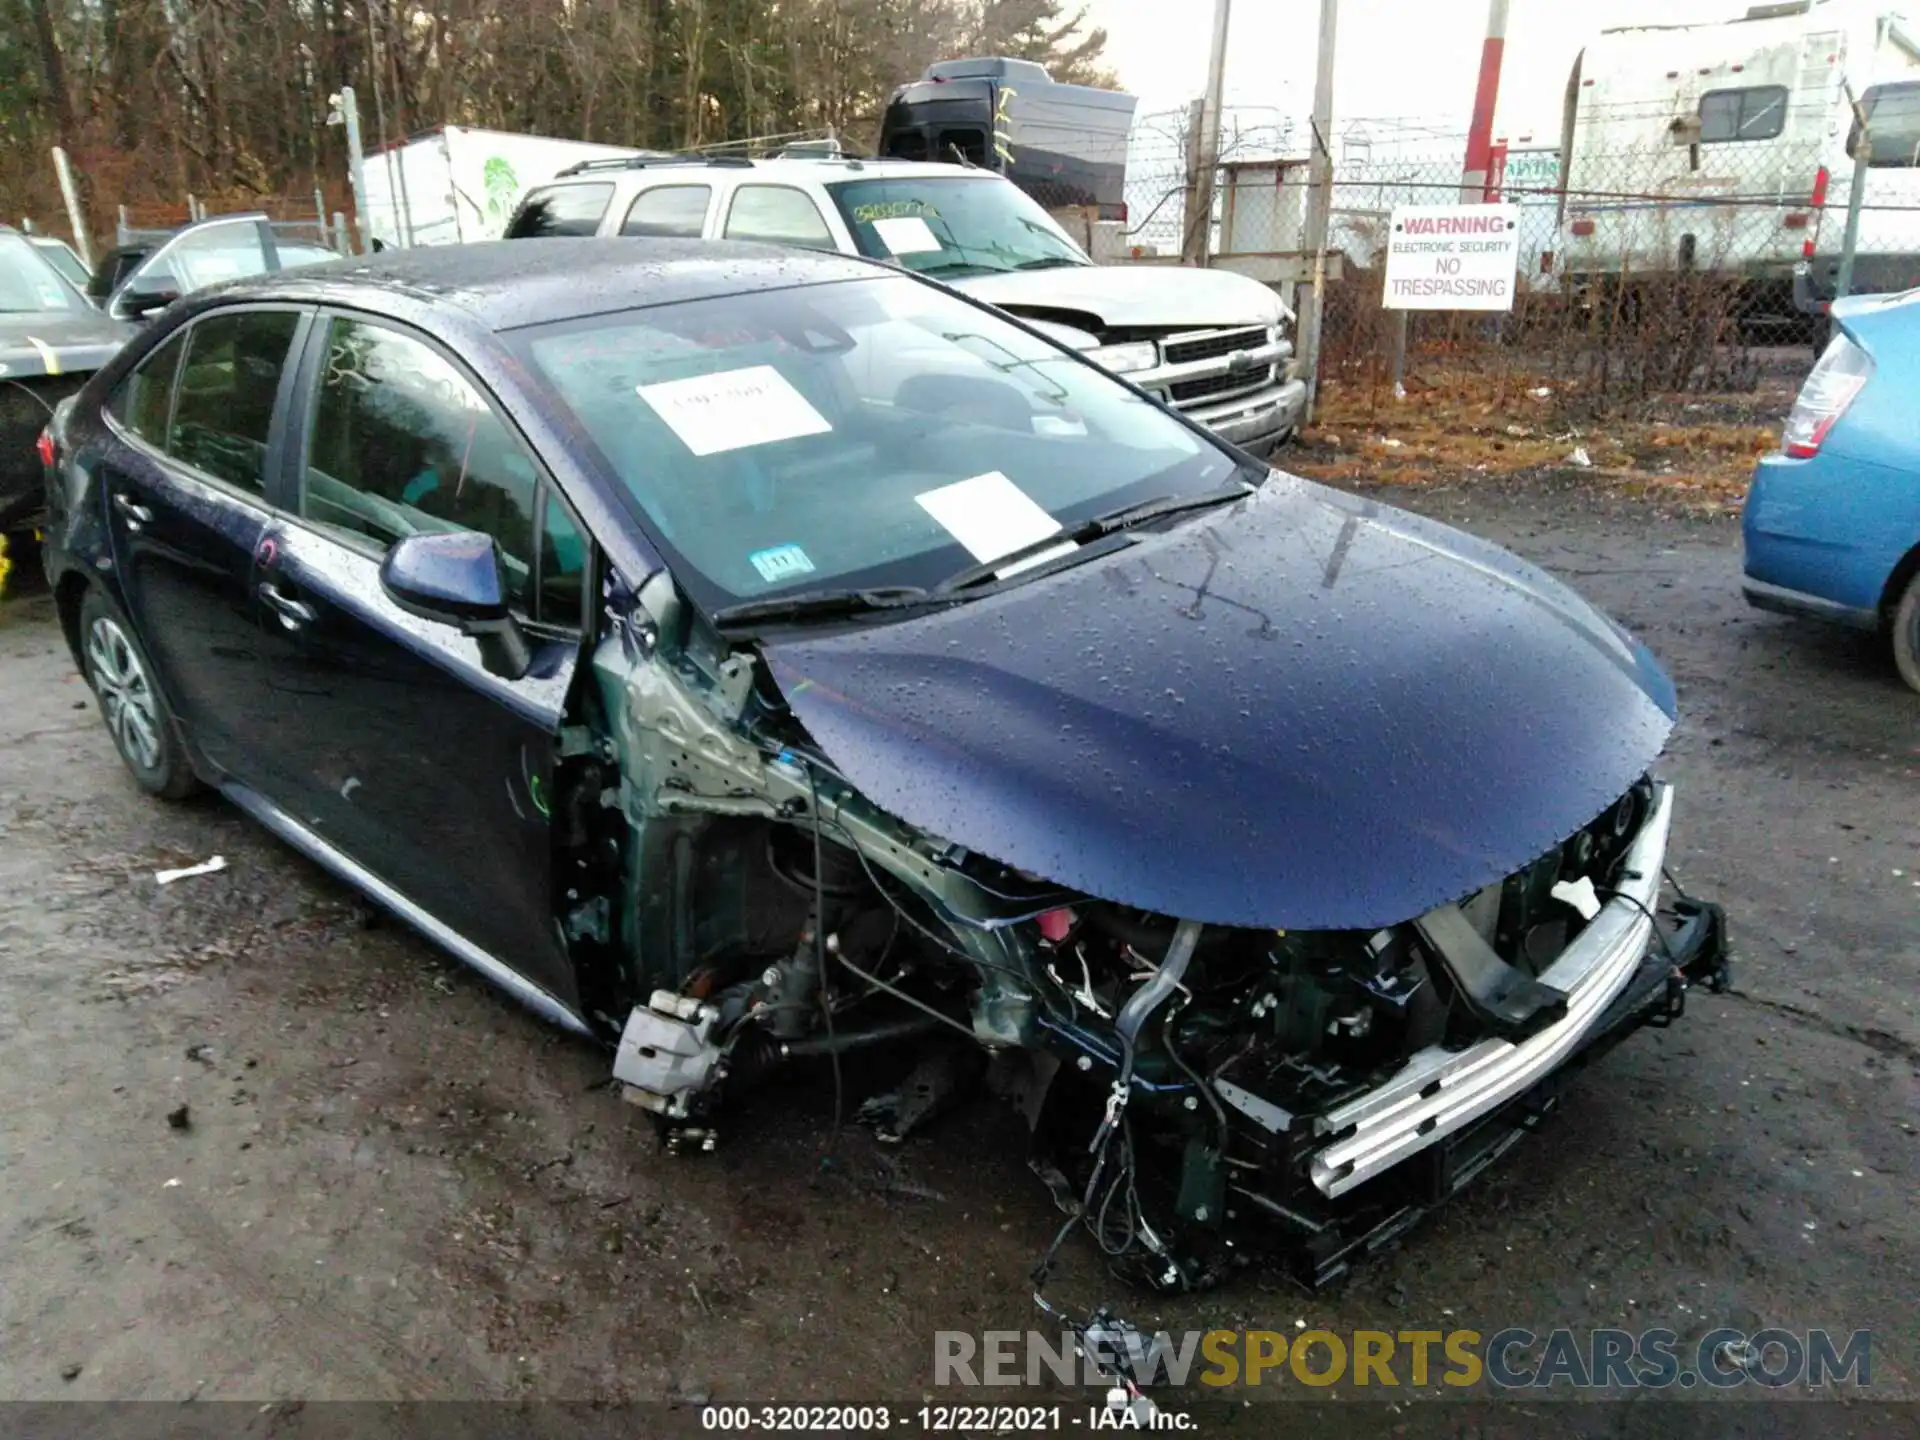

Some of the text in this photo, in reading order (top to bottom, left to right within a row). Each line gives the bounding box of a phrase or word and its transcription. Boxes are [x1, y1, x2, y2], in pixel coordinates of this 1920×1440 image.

[1403, 215, 1505, 235] WARNING
[1392, 241, 1513, 253] ELECTRONIC SECURITY
[1434, 257, 1462, 275] NO
[1391, 278, 1506, 297] TRESPASSING
